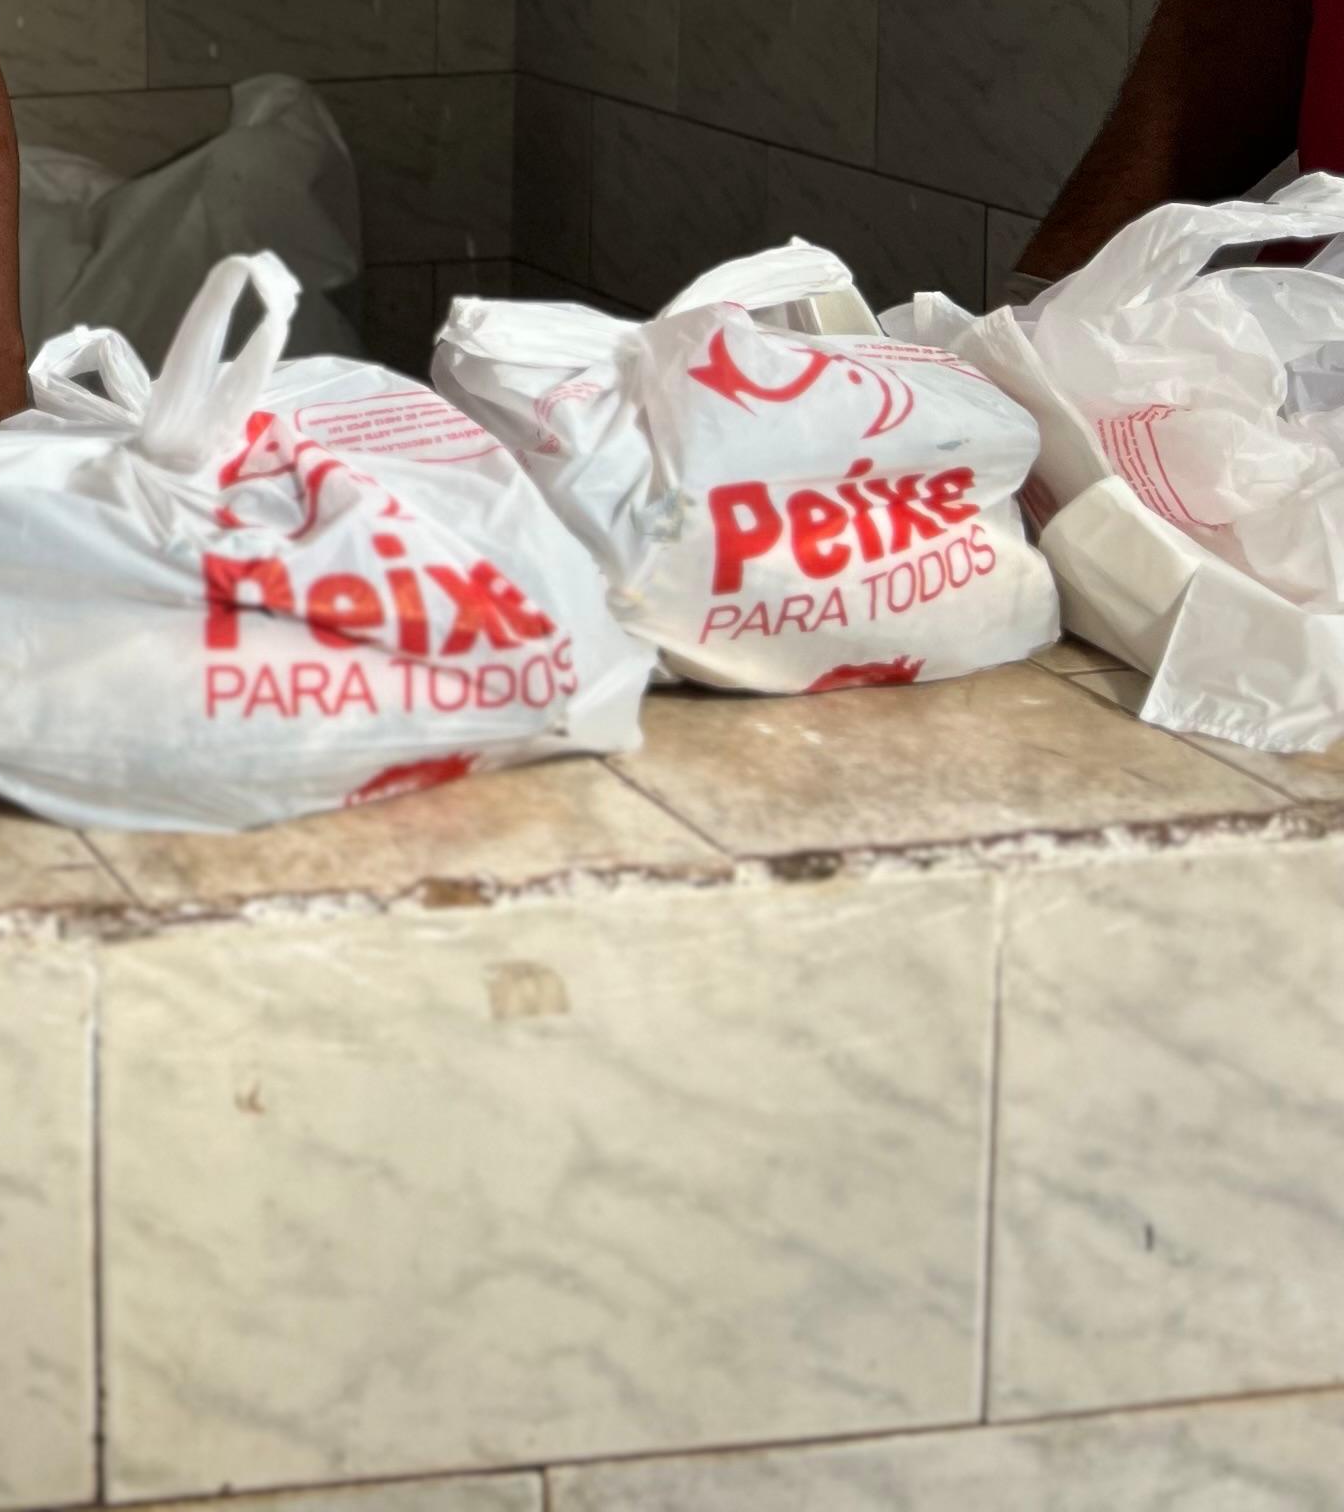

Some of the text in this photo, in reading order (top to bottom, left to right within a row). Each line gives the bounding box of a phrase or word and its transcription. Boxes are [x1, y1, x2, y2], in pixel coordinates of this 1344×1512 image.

[699, 524, 997, 644] PARA TODOS
[708, 457, 980, 596] Peixe
[205, 636, 577, 718] PARA TODOS
